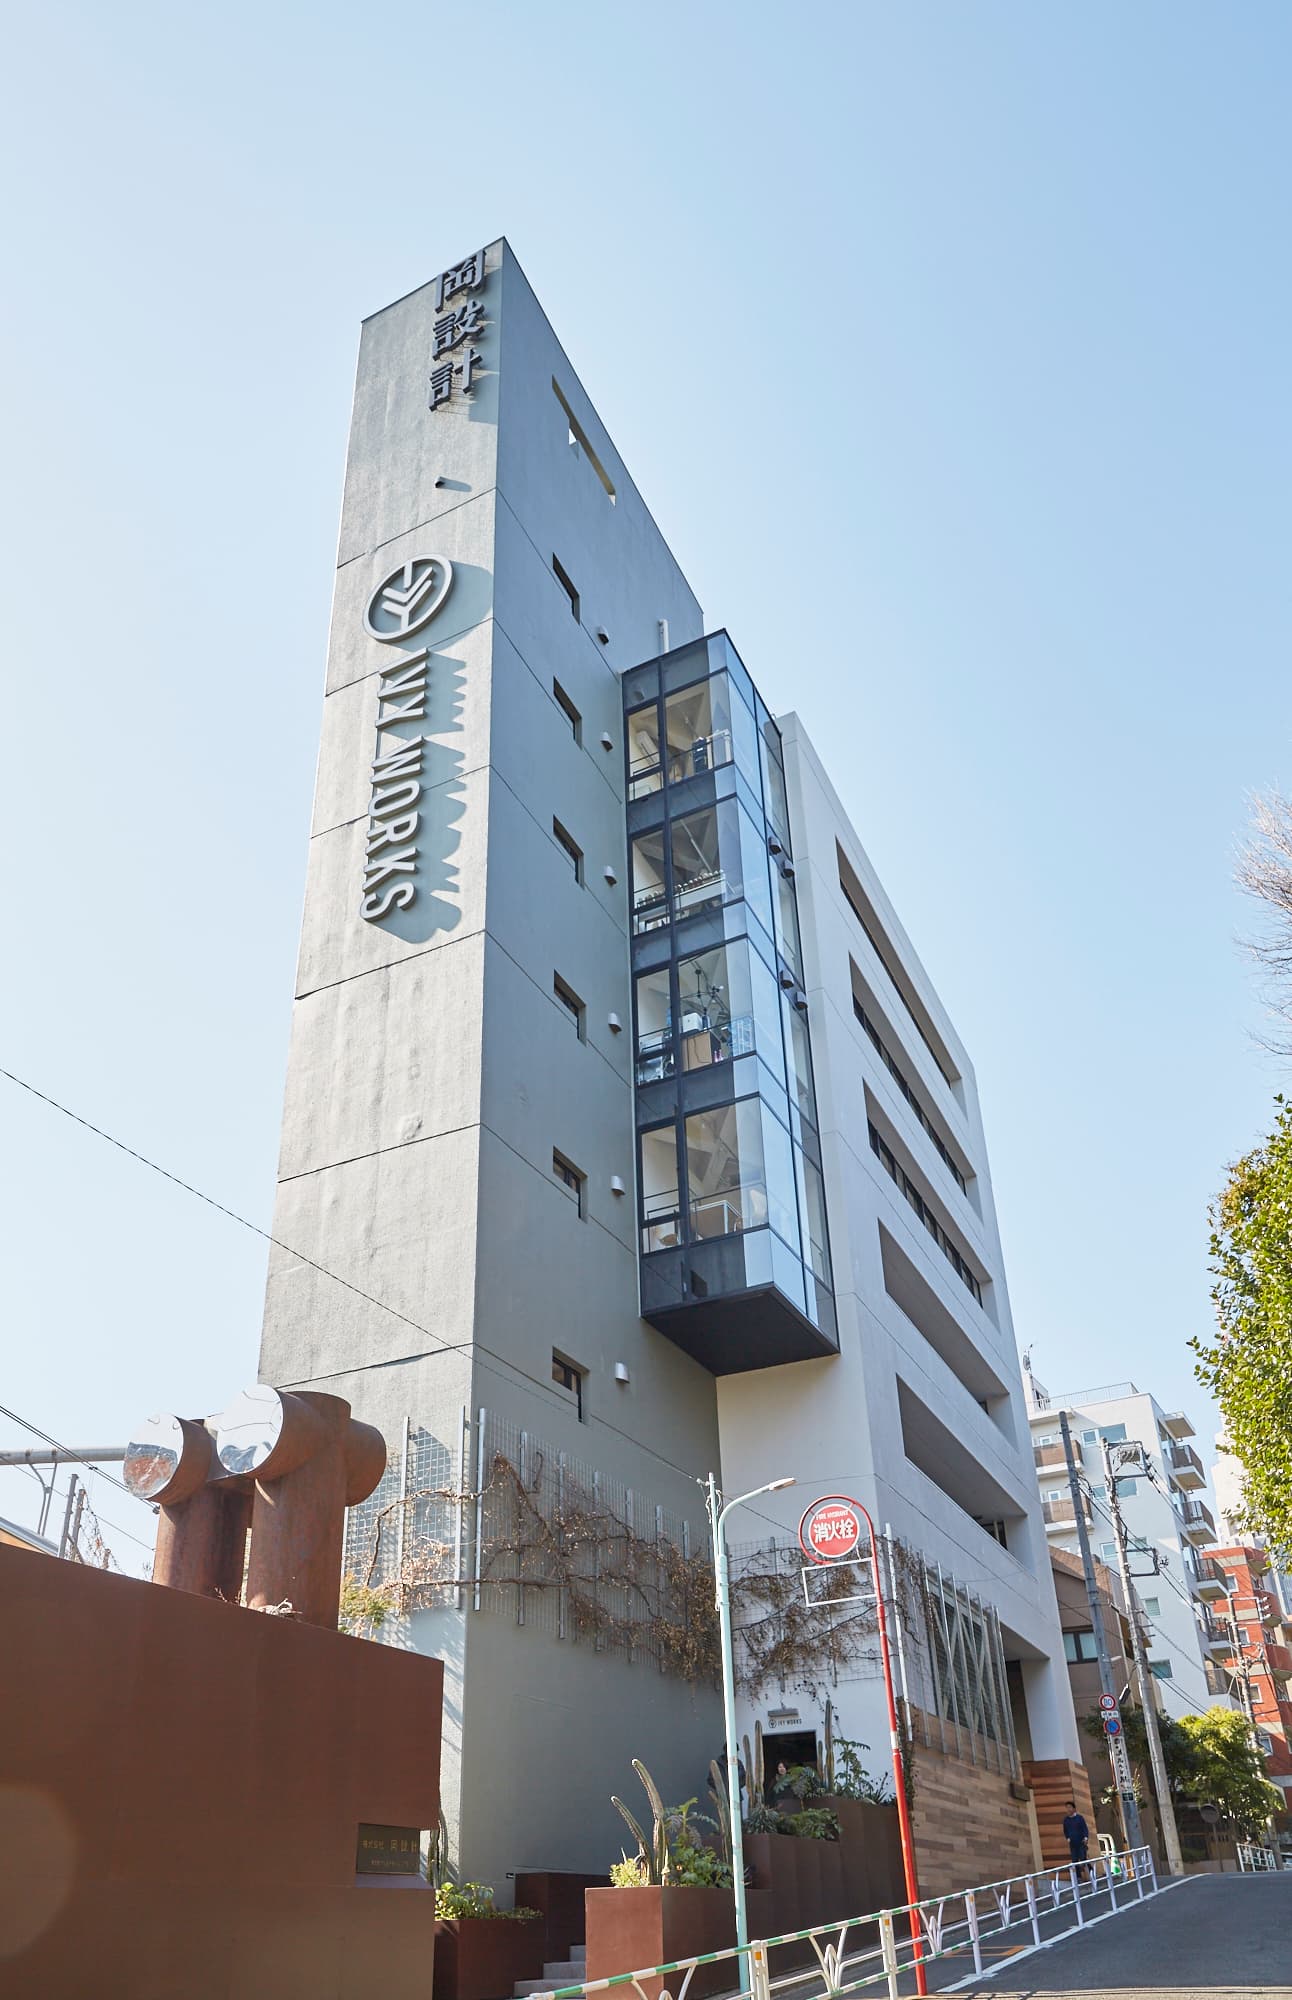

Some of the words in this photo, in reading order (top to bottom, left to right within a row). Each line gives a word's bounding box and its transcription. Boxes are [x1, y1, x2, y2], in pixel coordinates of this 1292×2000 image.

[429, 250, 486, 412] 岡設計
[375, 647, 430, 730] IVY
[360, 735, 427, 922] WORKS
[813, 1518, 855, 1544] 消火栓
